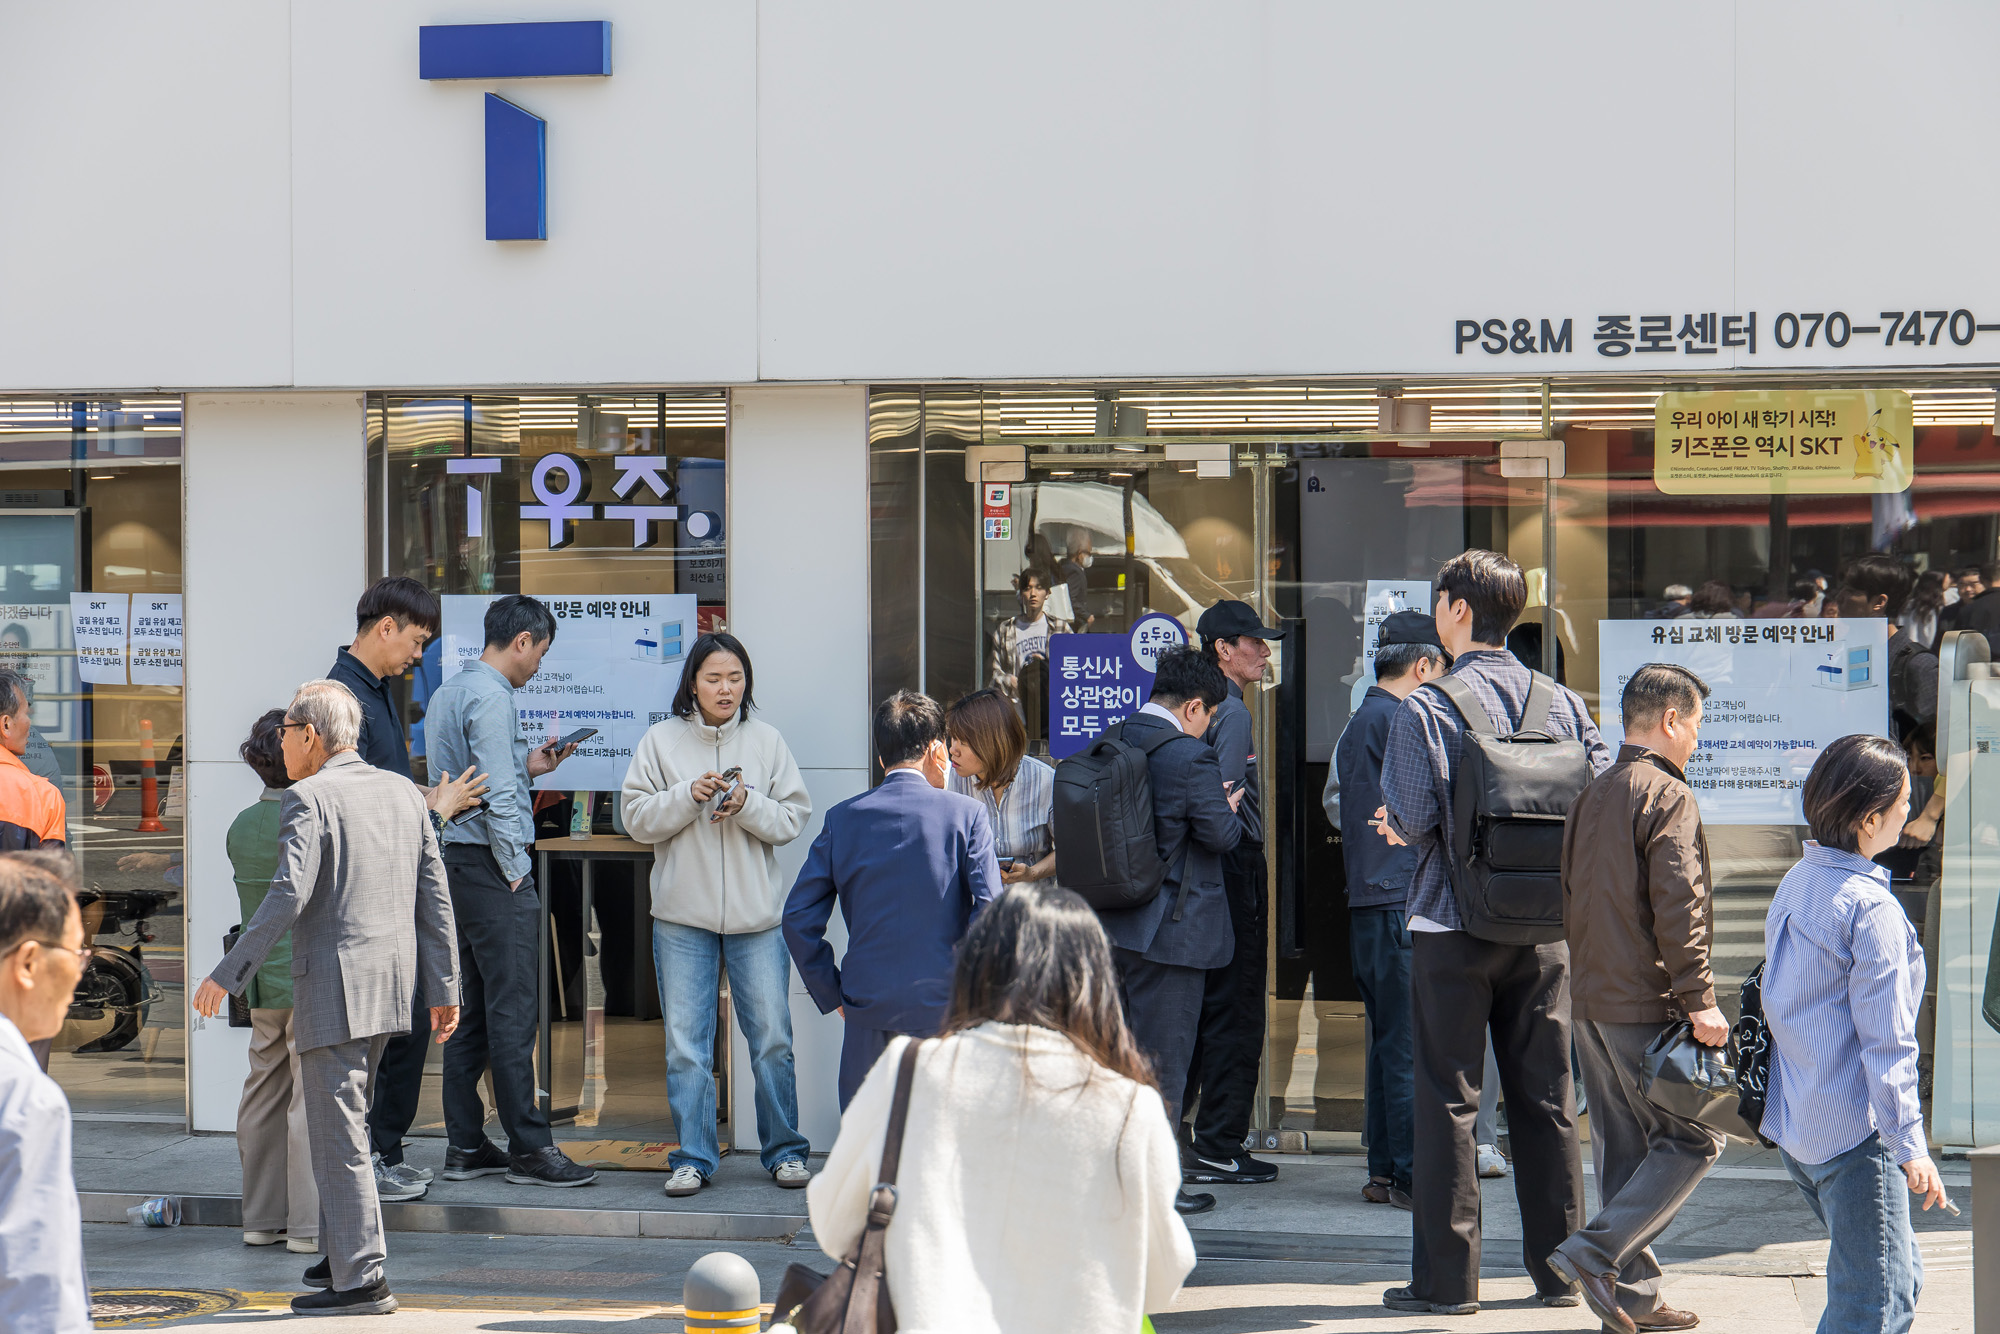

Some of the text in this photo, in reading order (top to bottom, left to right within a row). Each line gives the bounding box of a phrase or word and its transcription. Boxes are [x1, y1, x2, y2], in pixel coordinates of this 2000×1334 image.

[419, 20, 613, 242] T
[1455, 318, 1574, 355] PS&M
[1592, 311, 1757, 358] 종로센터
[1670, 410, 1836, 430] 우리 아이 새 학기 시작!
[1671, 435, 1843, 459] 키즈폰은 역시 SKT
[986, 525, 1009, 533] JCB
[689, 572, 714, 583] 최선을
[1388, 590, 1407, 599] SKT
[90, 602, 107, 610] SKT
[151, 602, 169, 611] SKT
[553, 601, 584, 619] 방문
[586, 601, 617, 619] 예약
[620, 600, 650, 618] 안내
[78, 616, 120, 625] 금일 유심 재고
[138, 617, 182, 626] 금일 유심 재고
[76, 626, 124, 636] 모두 소진 입니다.
[133, 628, 146, 636] 모두
[148, 628, 162, 636] 소진
[1139, 626, 1176, 644] 모두의
[1651, 625, 1835, 645] 유심 교체 방문 예약 안내
[81, 647, 119, 656] 금일 유심 재고
[138, 648, 181, 657] 금일 유심 재고
[80, 656, 123, 666] 모두 소진 입니다.
[133, 658, 146, 667] 모두
[148, 659, 162, 667] 소진
[1060, 656, 1123, 680] 통신사
[543, 672, 573, 682] 고객님이
[528, 685, 542, 694] 유심
[543, 685, 566, 694] 교체가
[566, 684, 605, 695] 어렵습니다.
[1060, 685, 1141, 710] 상관없이
[1713, 700, 1746, 710] 고객님이
[528, 709, 558, 720] 통해서만
[558, 710, 573, 719] 교체
[573, 709, 596, 719] 예약이
[597, 709, 636, 719] 가능합니다.
[1713, 713, 1738, 723] 교체가
[1739, 713, 1783, 723] 어렵습니다.
[536, 722, 544, 731] 후
[1060, 715, 1102, 739] 모두
[1729, 740, 1746, 749] 교체
[1746, 739, 1772, 750] 예약이
[1773, 739, 1817, 750] 가능합니다.
[1705, 753, 1714, 762] 후
[1731, 766, 1781, 777] 방문해주시면
[1718, 780, 1736, 789] 다해
